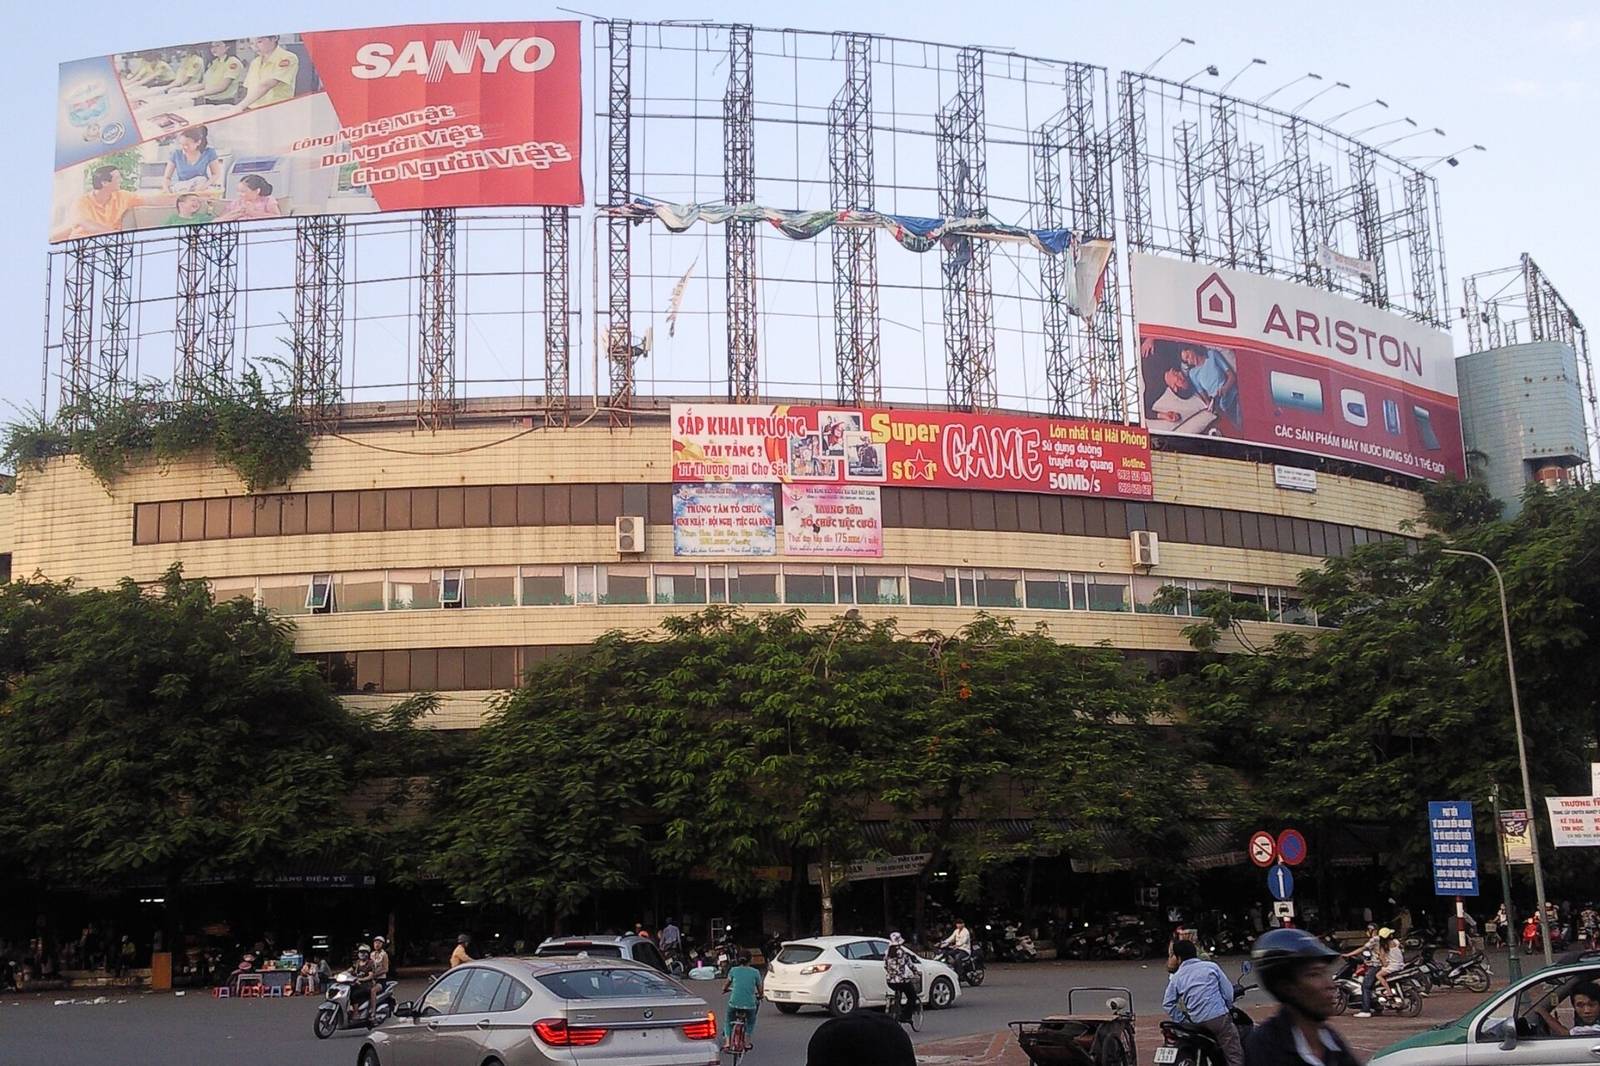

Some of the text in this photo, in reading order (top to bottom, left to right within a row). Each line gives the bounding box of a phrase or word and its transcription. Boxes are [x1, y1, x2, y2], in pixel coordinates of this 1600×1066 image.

[351, 30, 556, 83] SANYO
[292, 107, 455, 152] Công Nghệ Nhật
[321, 126, 482, 167] Do Người Việt
[352, 143, 569, 185] Cho Người Việt
[1263, 303, 1423, 377] ARISTON
[677, 407, 704, 436] SẮP
[707, 416, 744, 436] KHAI
[870, 413, 940, 446] Super
[1049, 423, 1148, 449] Lớn nhất tại Hải Phòng
[1274, 424, 1294, 438] CÁC
[1295, 426, 1314, 443] SẢN
[1341, 437, 1359, 452] MÁY
[758, 445, 763, 457] 3
[942, 423, 1043, 482] GAME
[1090, 460, 1114, 473] quang
[1049, 472, 1101, 493] 50Mb/s
